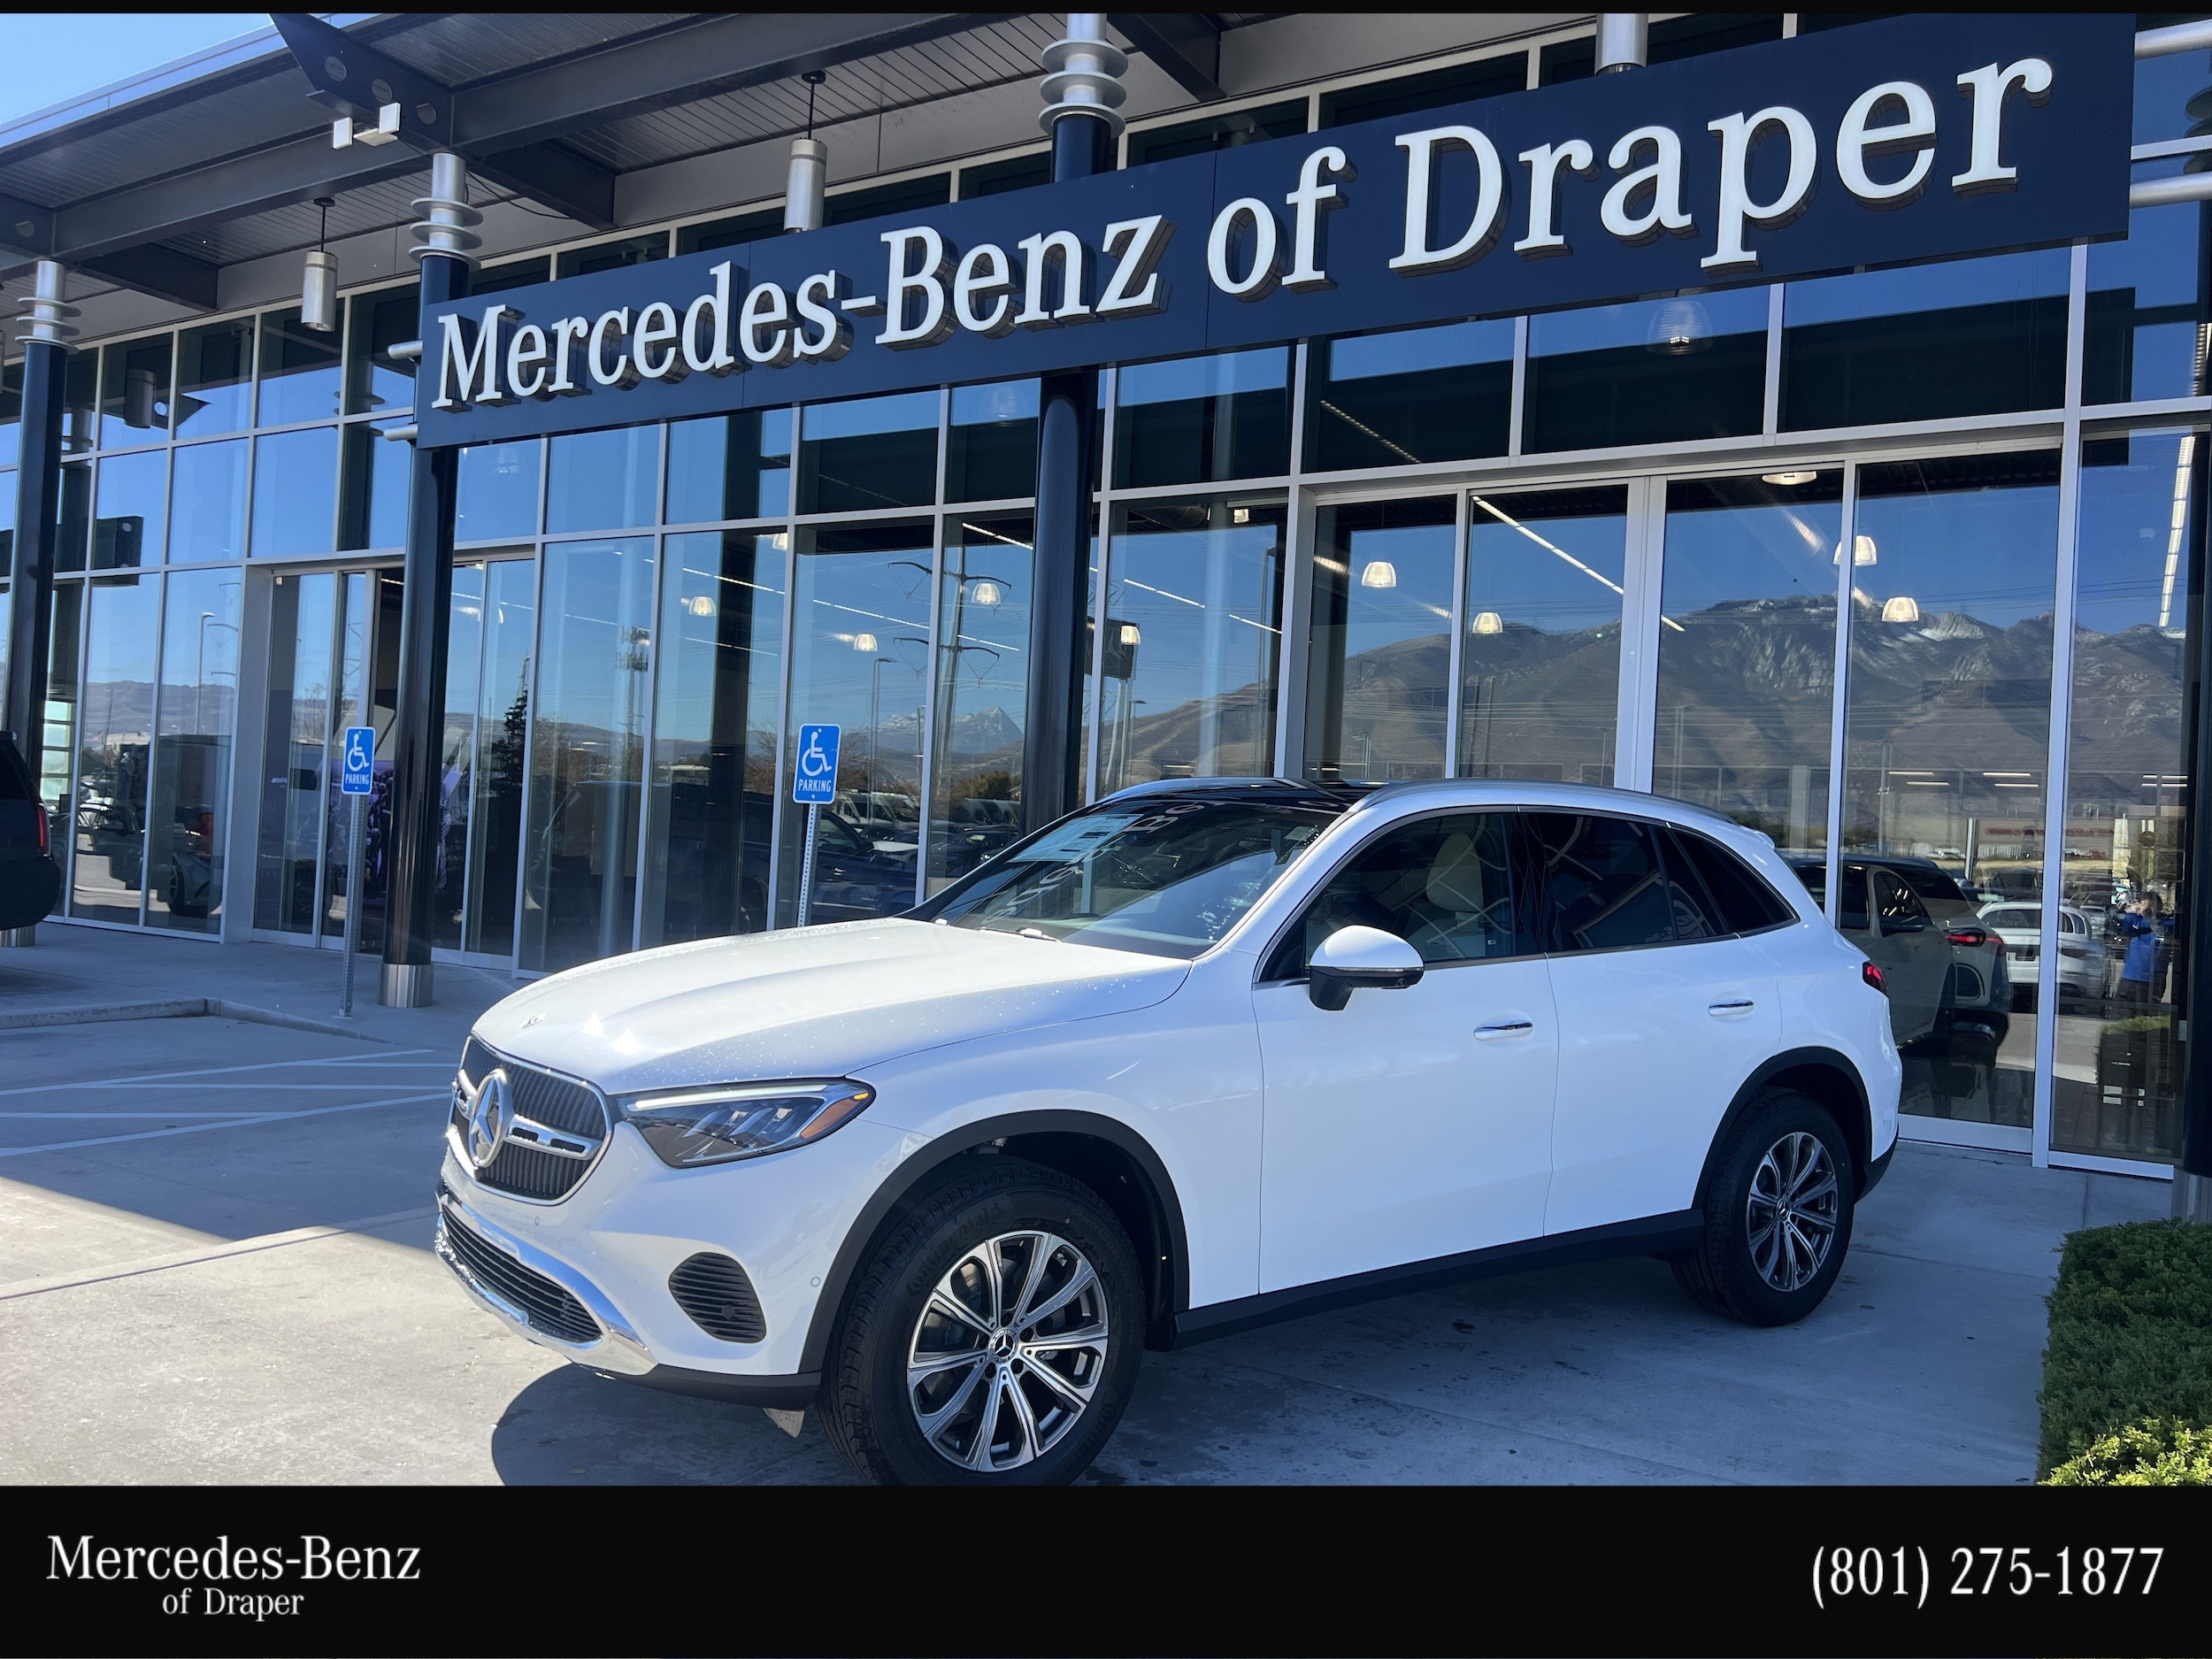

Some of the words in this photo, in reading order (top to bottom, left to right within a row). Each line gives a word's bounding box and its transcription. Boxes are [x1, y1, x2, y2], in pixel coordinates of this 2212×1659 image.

[431, 214, 1164, 410] Mercedes-Benz
[1207, 146, 1347, 295] of
[1388, 58, 2053, 269] Draper
[345, 773, 370, 785] PARKING
[797, 779, 832, 793] PARKING
